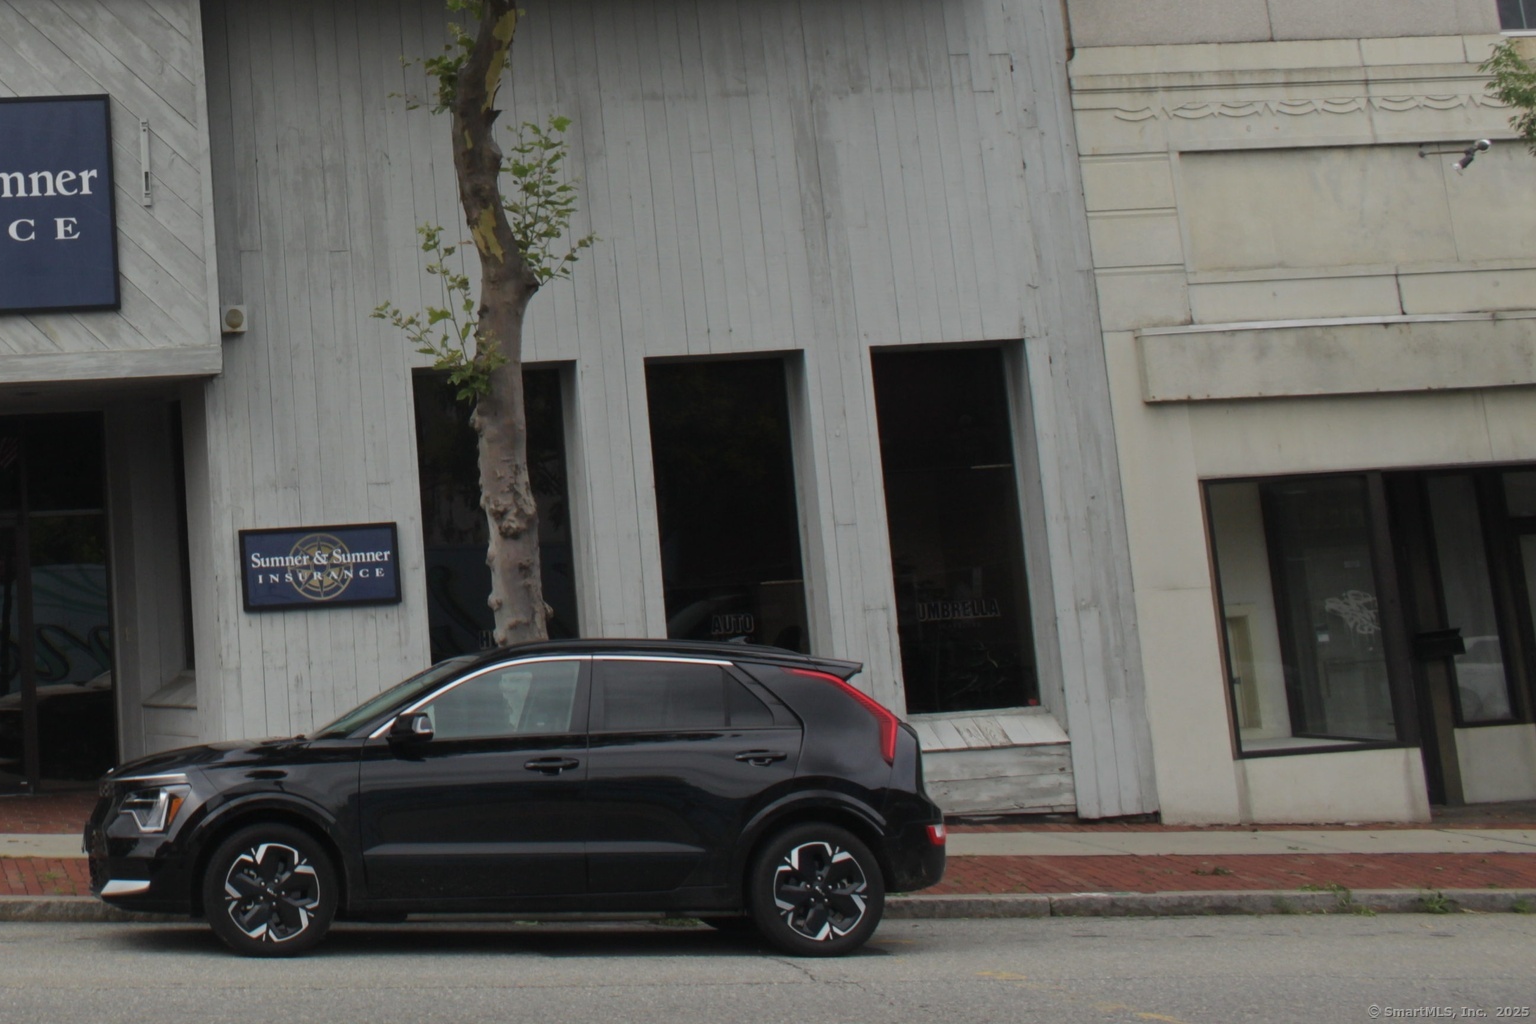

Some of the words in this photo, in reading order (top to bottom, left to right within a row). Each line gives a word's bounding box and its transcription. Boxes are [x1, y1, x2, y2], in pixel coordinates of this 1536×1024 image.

[251, 552, 310, 568] Sumner
[313, 550, 329, 565] &
[332, 548, 391, 564] Sumner
[258, 568, 385, 584] INSURANCE
[916, 598, 1001, 622] UMBRELLA
[711, 613, 755, 635] AUTO
